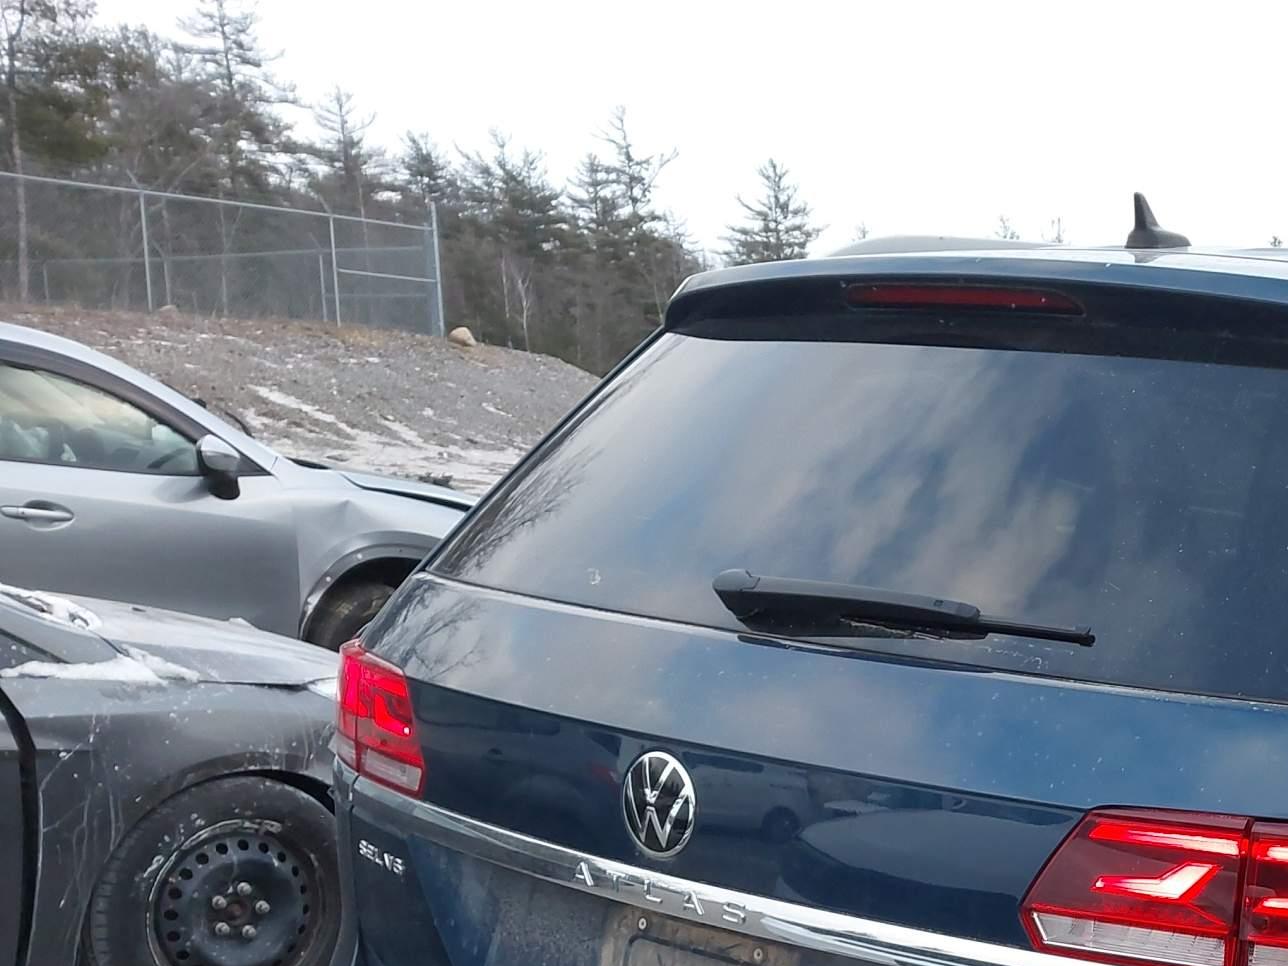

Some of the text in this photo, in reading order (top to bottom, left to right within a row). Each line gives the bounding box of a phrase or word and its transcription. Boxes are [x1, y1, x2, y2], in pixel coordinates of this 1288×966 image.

[359, 839, 404, 875] SEL V6
[573, 861, 747, 925] ATLAS
